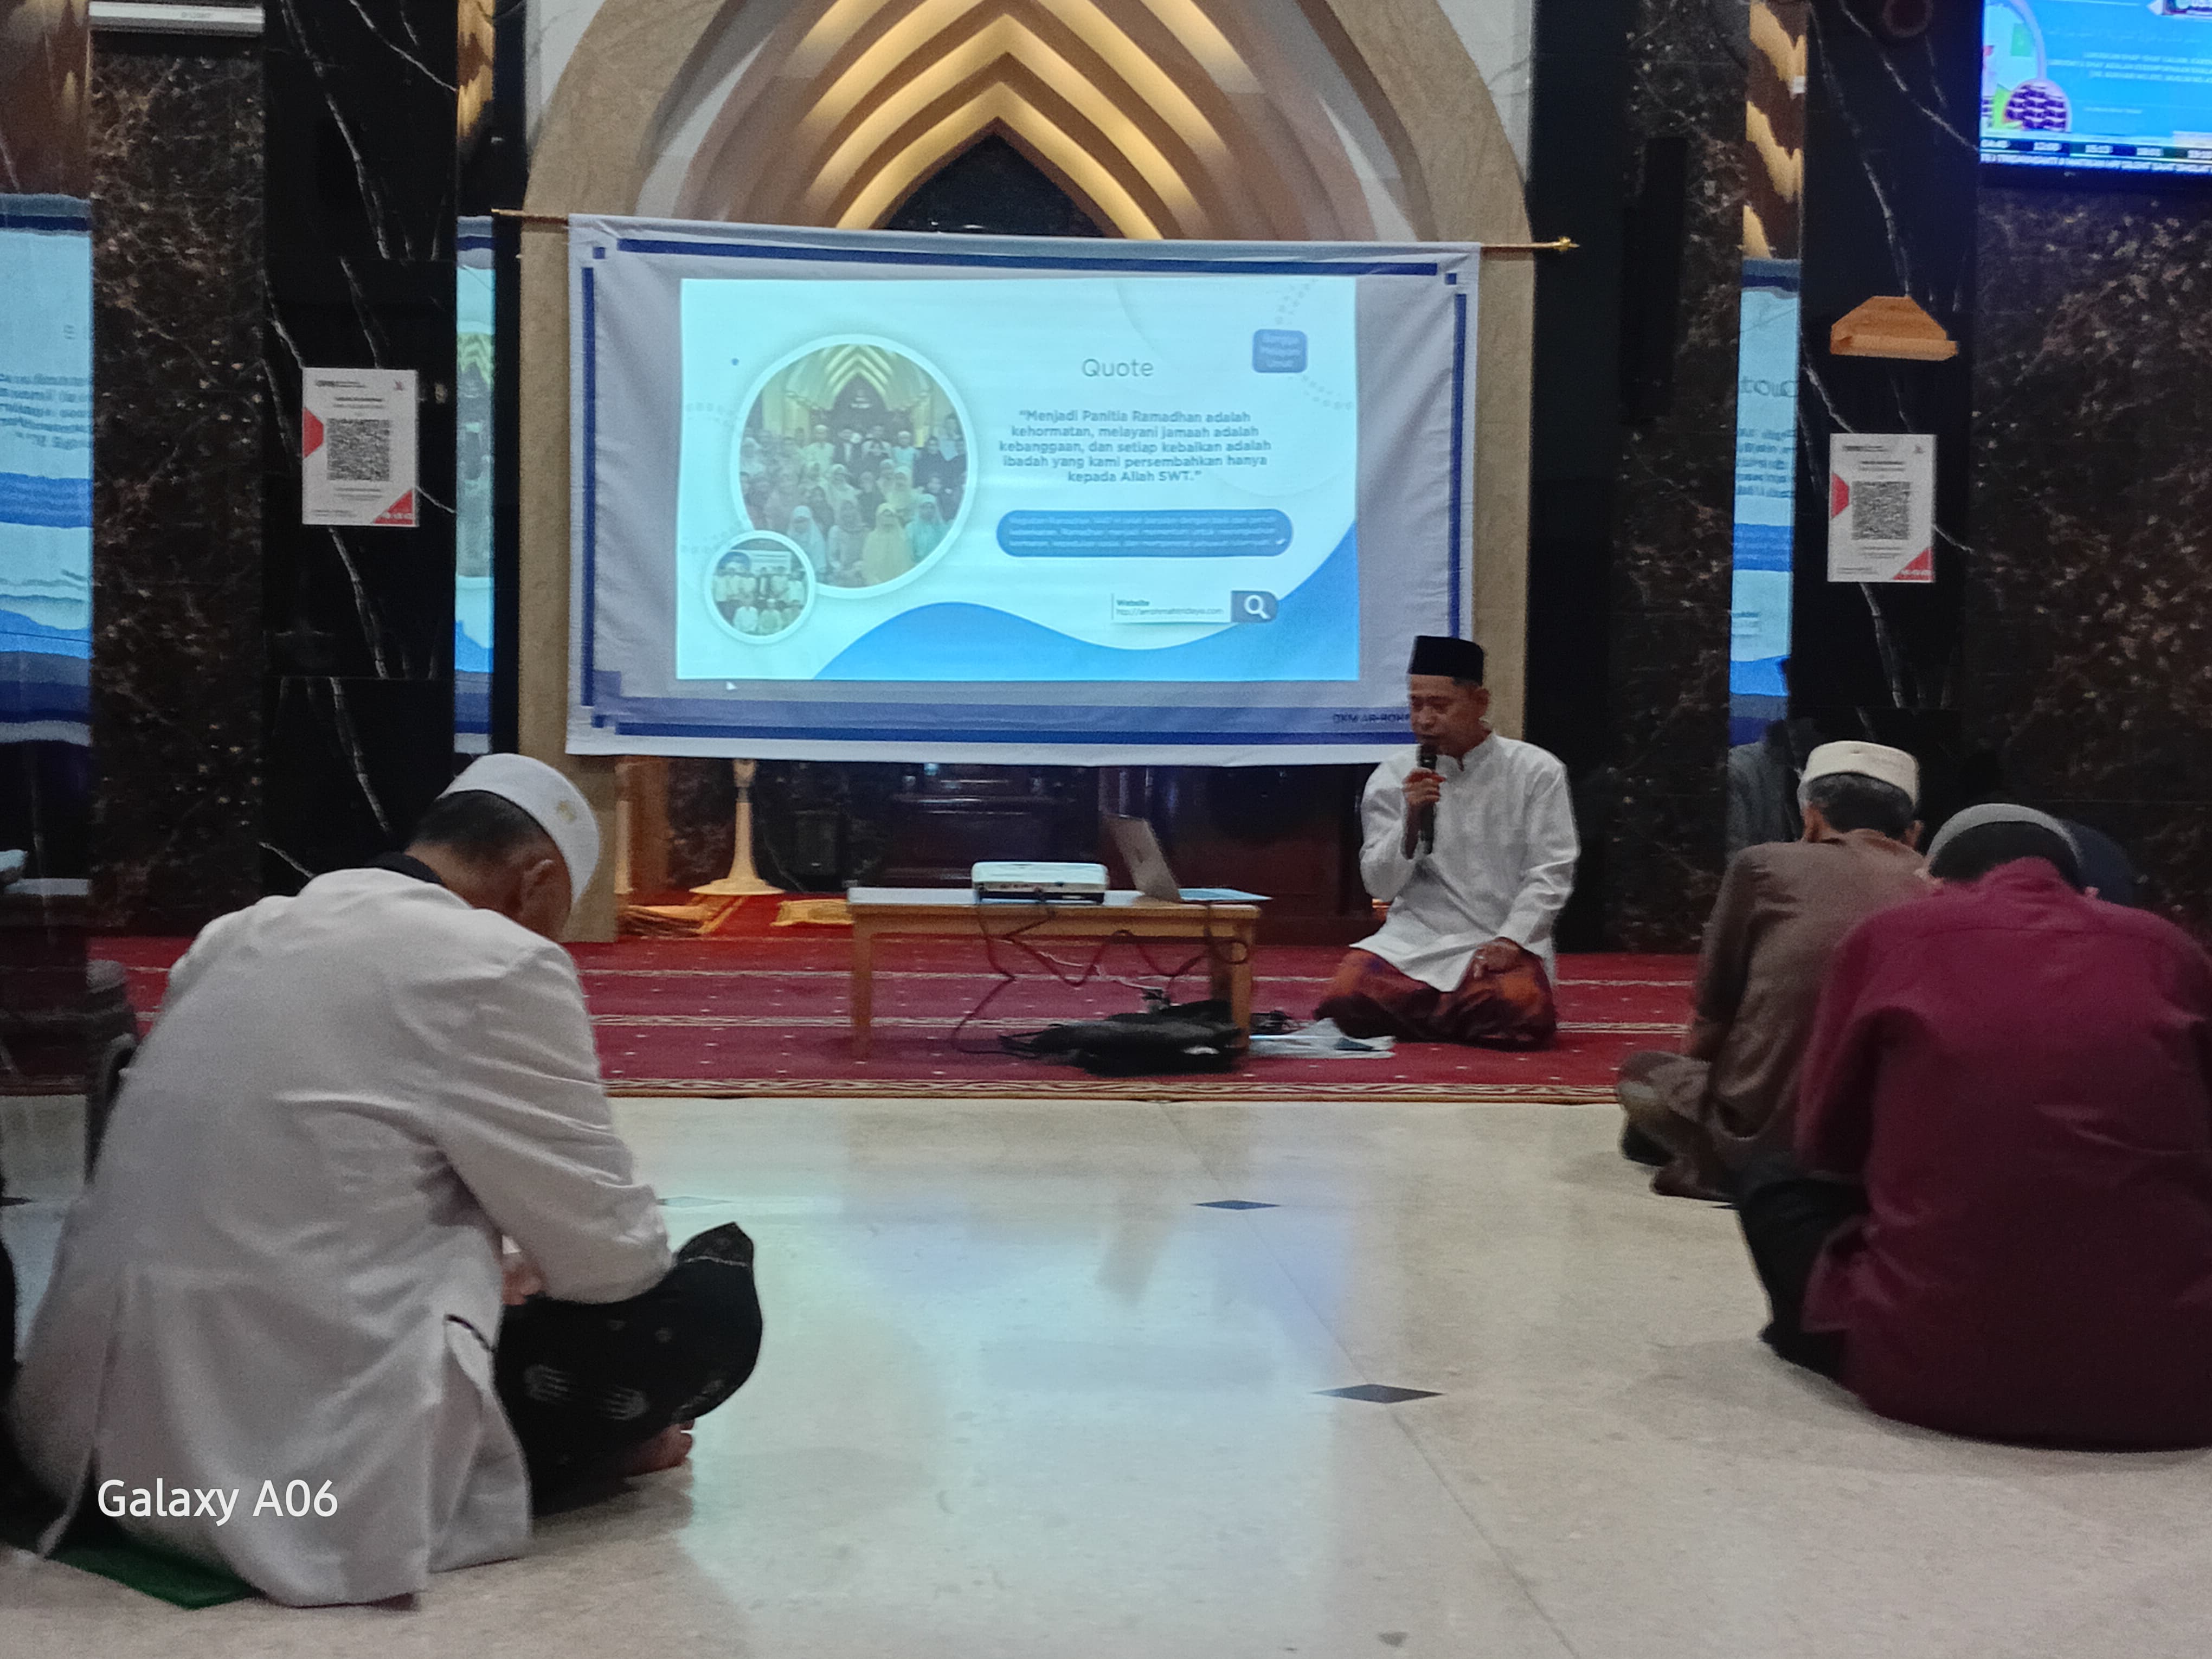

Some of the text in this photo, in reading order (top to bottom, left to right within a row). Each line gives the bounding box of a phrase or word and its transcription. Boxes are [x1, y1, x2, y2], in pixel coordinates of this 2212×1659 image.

[1082, 358, 1154, 377] Quote
[1083, 410, 1128, 421] Panitia
[1132, 410, 1202, 422] Ramadhan
[1205, 411, 1251, 422] adalah
[1011, 426, 1259, 439] kehormatan, melayani jamaah adalah
[999, 440, 1271, 454] kebanggaan, dan setiap kebaikan adalah
[1003, 455, 1267, 468] ibadah yang kami persembahkan hanya
[1068, 471, 1116, 483] kepada
[1121, 471, 1155, 481] Allah
